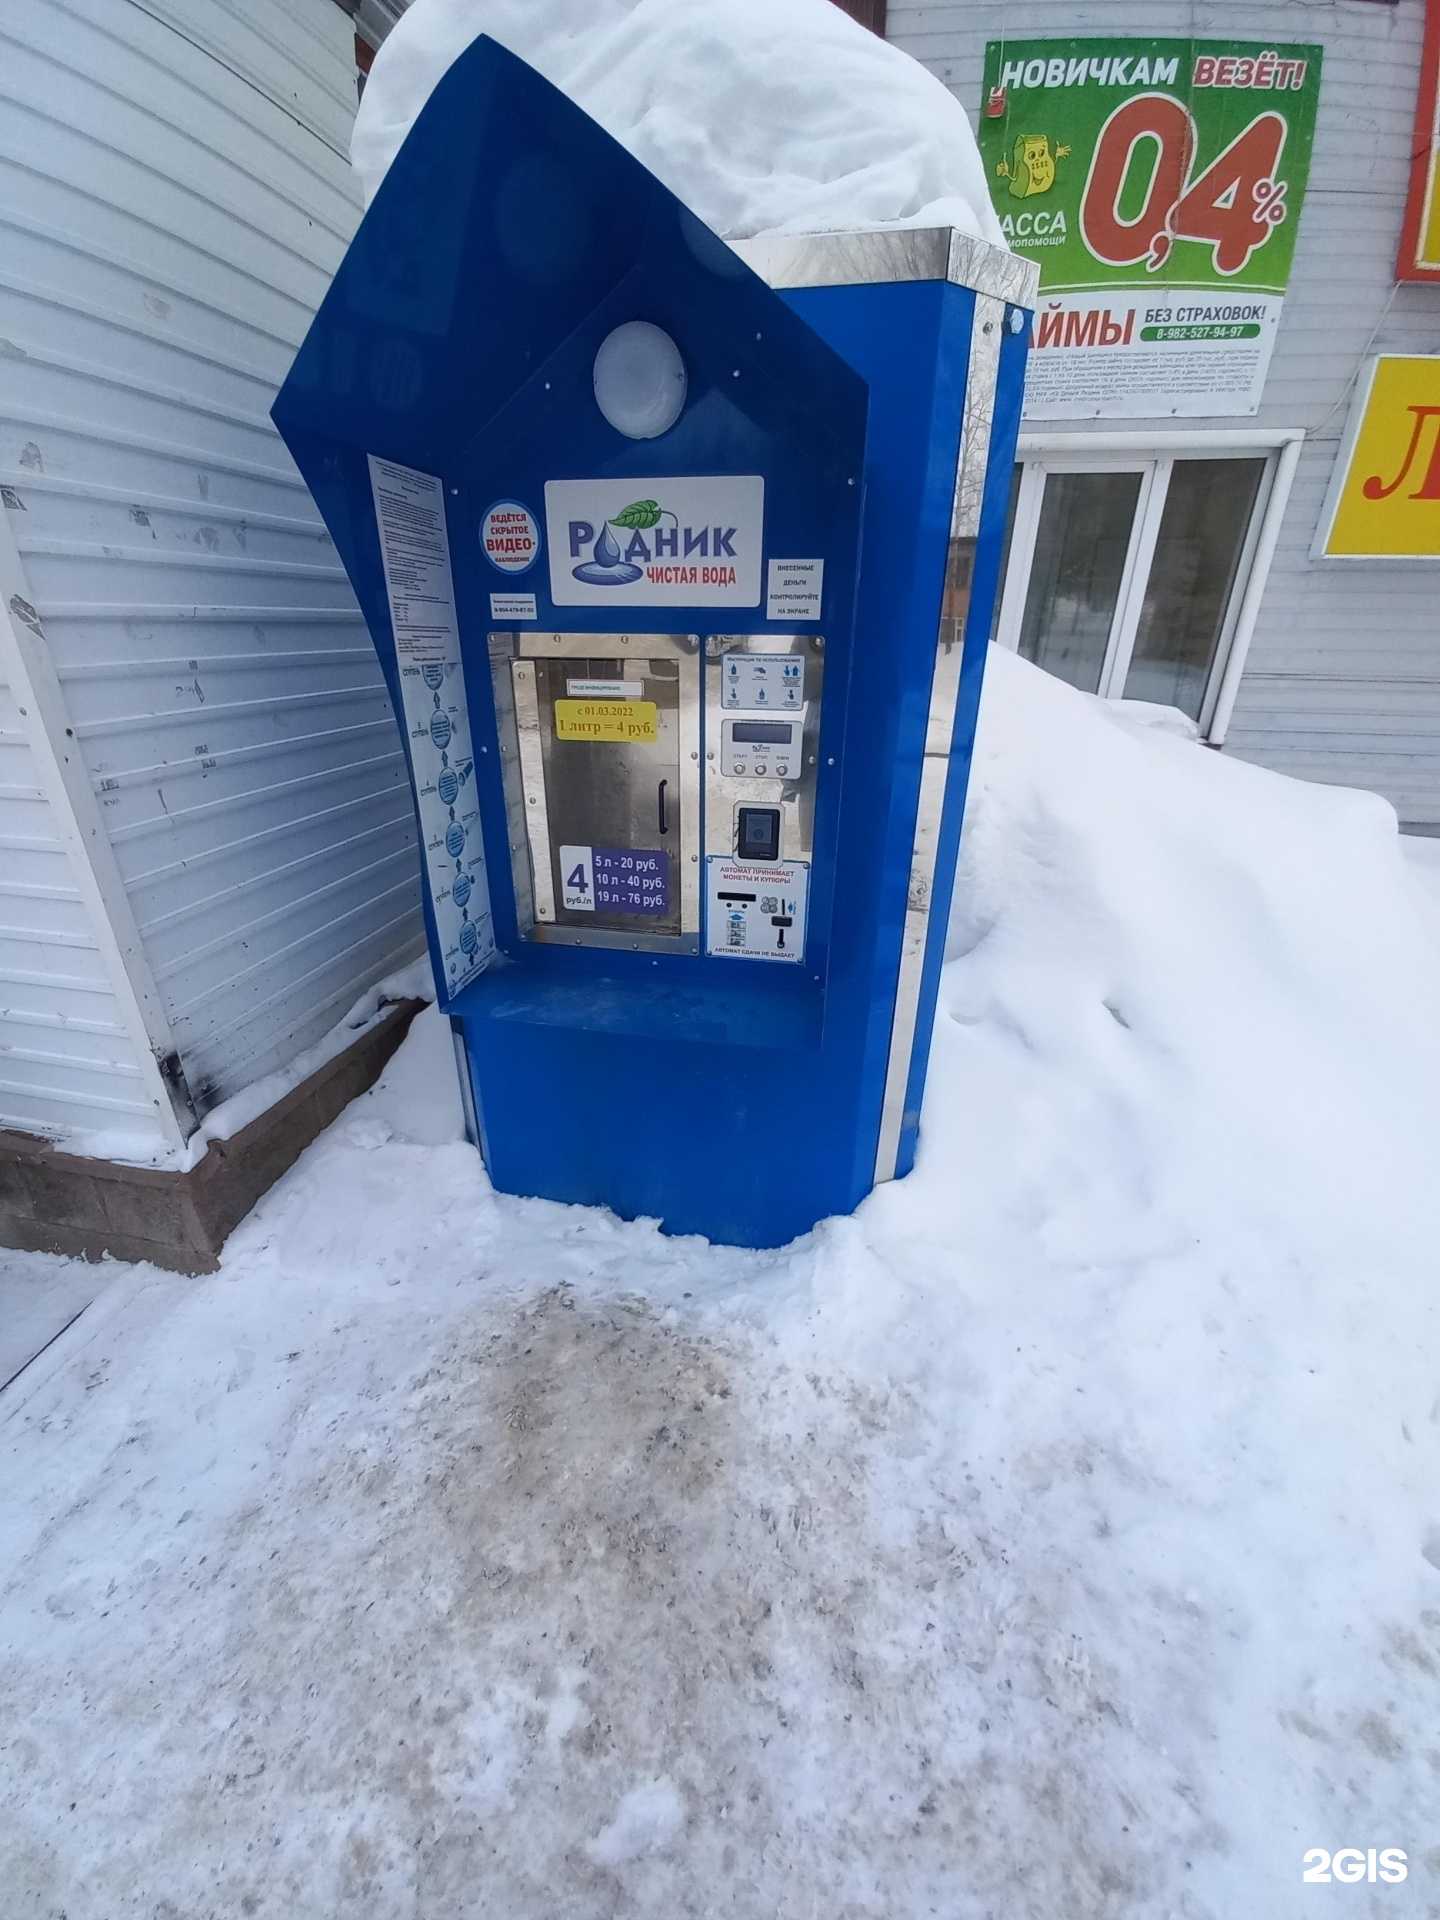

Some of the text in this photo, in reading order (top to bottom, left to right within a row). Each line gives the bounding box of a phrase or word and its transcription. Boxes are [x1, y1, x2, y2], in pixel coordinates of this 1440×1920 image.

[1001, 50, 1307, 90] НОВИЧКАМ ВЕЗЁТ!
[998, 210, 1067, 237] АССА
[1145, 305, 1266, 323] БЕЗ СТРАХОВОК!
[1028, 302, 1136, 350] ЙМЫ
[1156, 326, 1244, 340] 8-982-527-94-97
[490, 513, 527, 524] ВЕДЁТСЯ
[490, 526, 529, 535] СКРЫТОЕ
[646, 566, 737, 588] ЧИСТАЯ ВОДА
[585, 707, 633, 717] 01.03.2022
[569, 724, 601, 735] литр
[617, 721, 624, 733] 4
[628, 722, 655, 736] руб.
[595, 856, 602, 867] 5
[604, 859, 612, 867] л
[621, 857, 633, 869] 20
[636, 858, 659, 872] руб.
[720, 866, 751, 874] АВТОМАТ
[567, 863, 589, 894] 4
[597, 874, 608, 885] 10
[627, 875, 640, 887] 40
[642, 878, 665, 889] руб.
[598, 891, 609, 902] 19
[612, 895, 620, 903] л
[628, 893, 641, 904] 76
[643, 895, 665, 907] руб.
